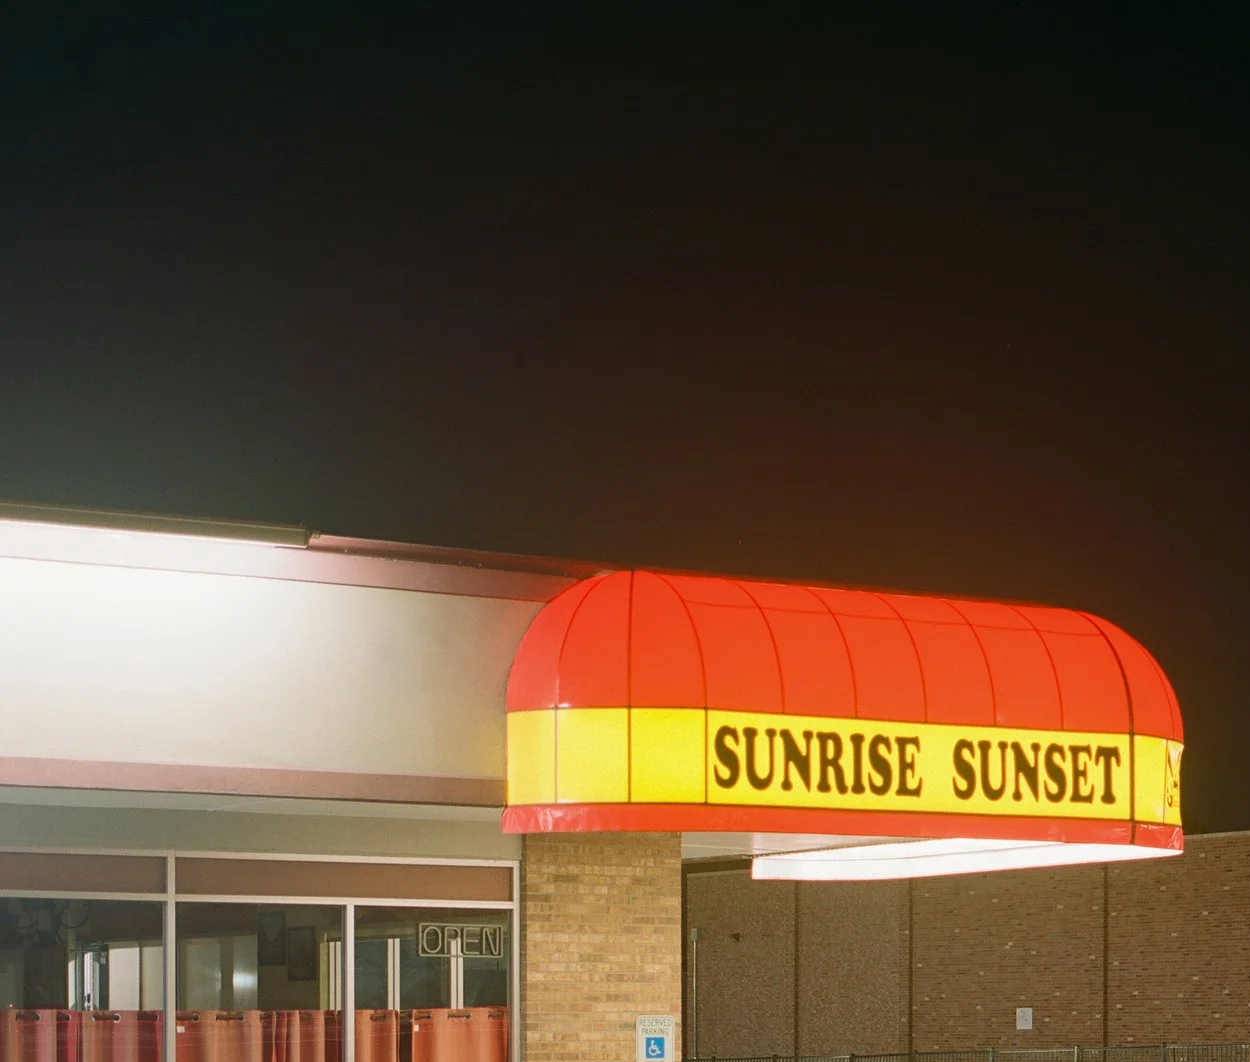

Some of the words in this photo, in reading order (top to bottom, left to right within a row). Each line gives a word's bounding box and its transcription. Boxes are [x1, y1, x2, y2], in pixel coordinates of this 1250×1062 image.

[713, 725, 923, 798] SUNRISE
[952, 738, 1122, 805] SUNSET
[423, 926, 500, 955] OPEN
[639, 1018, 671, 1027] RESERVED
[641, 1027, 669, 1036] PARKING
